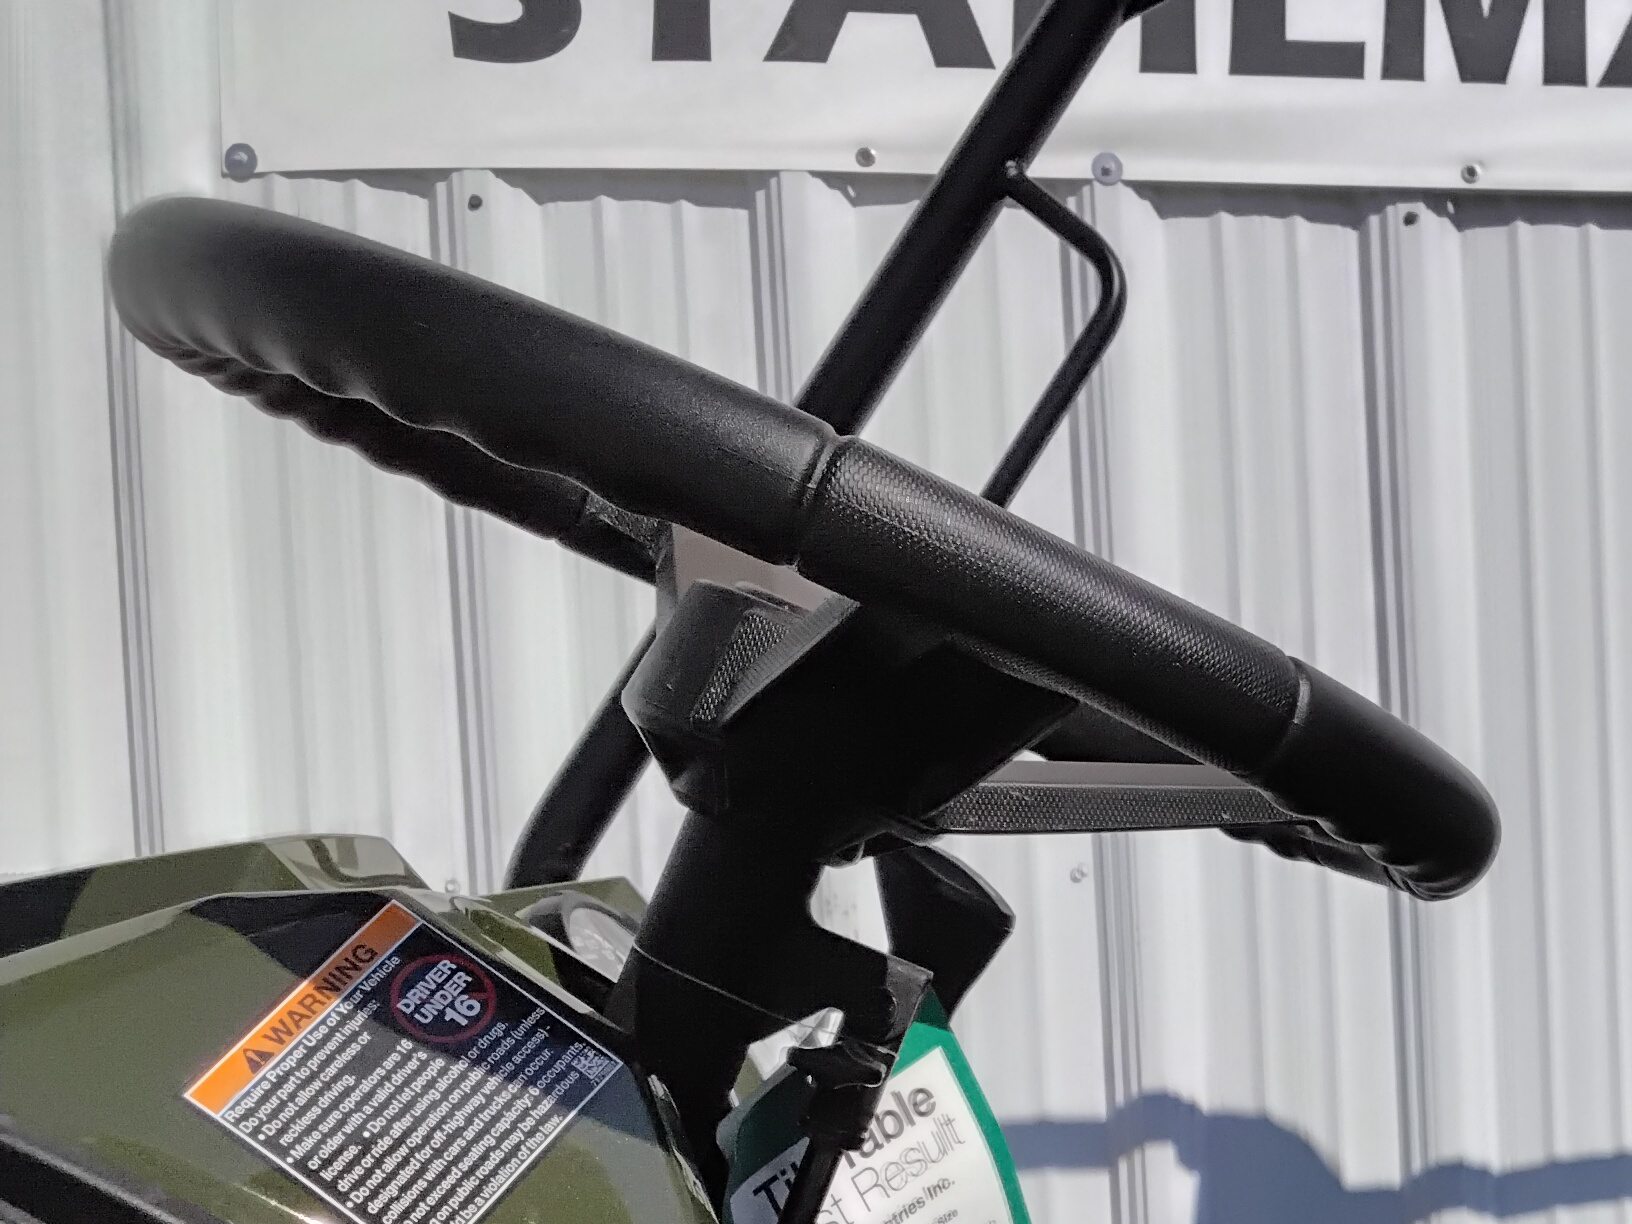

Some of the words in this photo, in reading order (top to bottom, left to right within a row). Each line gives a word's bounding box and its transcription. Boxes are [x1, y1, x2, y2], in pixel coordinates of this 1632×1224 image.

[260, 944, 379, 1046] WARNING
[395, 959, 457, 1015] DRIVER
[413, 971, 473, 1024] UNDER
[444, 994, 481, 1027] 16
[224, 1080, 272, 1123] Require
[265, 1044, 308, 1083] Proper
[301, 1025, 329, 1047] Use
[326, 1011, 341, 1027] of
[334, 989, 364, 1014] Your
[358, 956, 401, 992] Vehicle
[238, 1117, 259, 1134] Do
[254, 1095, 281, 1122] your
[276, 1075, 302, 1101] part
[293, 1067, 311, 1080] to
[306, 1032, 347, 1072] prevent
[338, 999, 381, 1036] injuries:
[261, 1119, 283, 1137] Do
[280, 1102, 300, 1119] not
[294, 1078, 323, 1107] allow
[319, 1042, 362, 1082] careless
[357, 1031, 372, 1045] or
[391, 1051, 428, 1086] driver's
[278, 1105, 322, 1147] reckless
[317, 1074, 356, 1108] driving.
[289, 1130, 322, 1160] Make
[318, 1110, 343, 1133] sure
[338, 1066, 387, 1113] operators
[382, 1052, 402, 1070] are
[396, 1038, 414, 1054] 16
[337, 1165, 365, 1192] drive
[360, 1153, 375, 1168] or
[370, 1135, 394, 1158] ride
[389, 1112, 414, 1139] after
[409, 1088, 441, 1117] using
[435, 1055, 471, 1092] alcohol
[467, 1045, 481, 1059] or
[341, 1112, 367, 1134] with
[349, 1186, 370, 1204] Do
[365, 1169, 387, 1190] not
[381, 1144, 410, 1173] allow
[405, 1101, 453, 1148] operation
[448, 1088, 465, 1104] on
[459, 1061, 491, 1094] public
[486, 1037, 516, 1065] roads
[509, 1007, 546, 1040] (unless
[362, 1105, 375, 1115] a
[366, 1116, 387, 1134] Do
[382, 1099, 404, 1120] not
[395, 1087, 416, 1104] let
[409, 1057, 446, 1093] people
[367, 1157, 421, 1215] designated
[414, 1144, 434, 1163] for
[430, 1091, 486, 1149] off-highway
[479, 1061, 515, 1095] vehicle
[511, 1028, 550, 1064] access)
[368, 1081, 396, 1107] valid
[409, 1201, 431, 1223] not
[426, 1166, 463, 1206] exceed
[457, 1134, 496, 1172] seating
[527, 1085, 540, 1096] 6
[536, 1041, 588, 1089] occupants.
[422, 1158, 448, 1181] with
[443, 1137, 467, 1161] cars
[462, 1117, 485, 1141] and
[477, 1090, 512, 1122] trucks
[507, 1071, 528, 1094] can
[524, 1048, 554, 1076] occur.
[307, 1155, 322, 1170] or
[318, 1130, 346, 1159] older
[319, 1145, 363, 1182] license.
[436, 1205, 453, 1221] on
[447, 1175, 480, 1210] public
[474, 1149, 505, 1180] roads
[500, 1128, 525, 1153] may
[517, 1116, 536, 1133] be
[529, 1070, 580, 1120] hazardous
[459, 1203, 478, 1220] be
[473, 1196, 485, 1207] a
[479, 1157, 521, 1199] violation
[517, 1144, 531, 1160] of
[525, 1132, 545, 1150] the
[538, 1114, 563, 1135] law.
[753, 1161, 800, 1217] Ti
[846, 1087, 937, 1170] able
[851, 1113, 966, 1212] Result
[926, 1176, 956, 1201] Inc.
